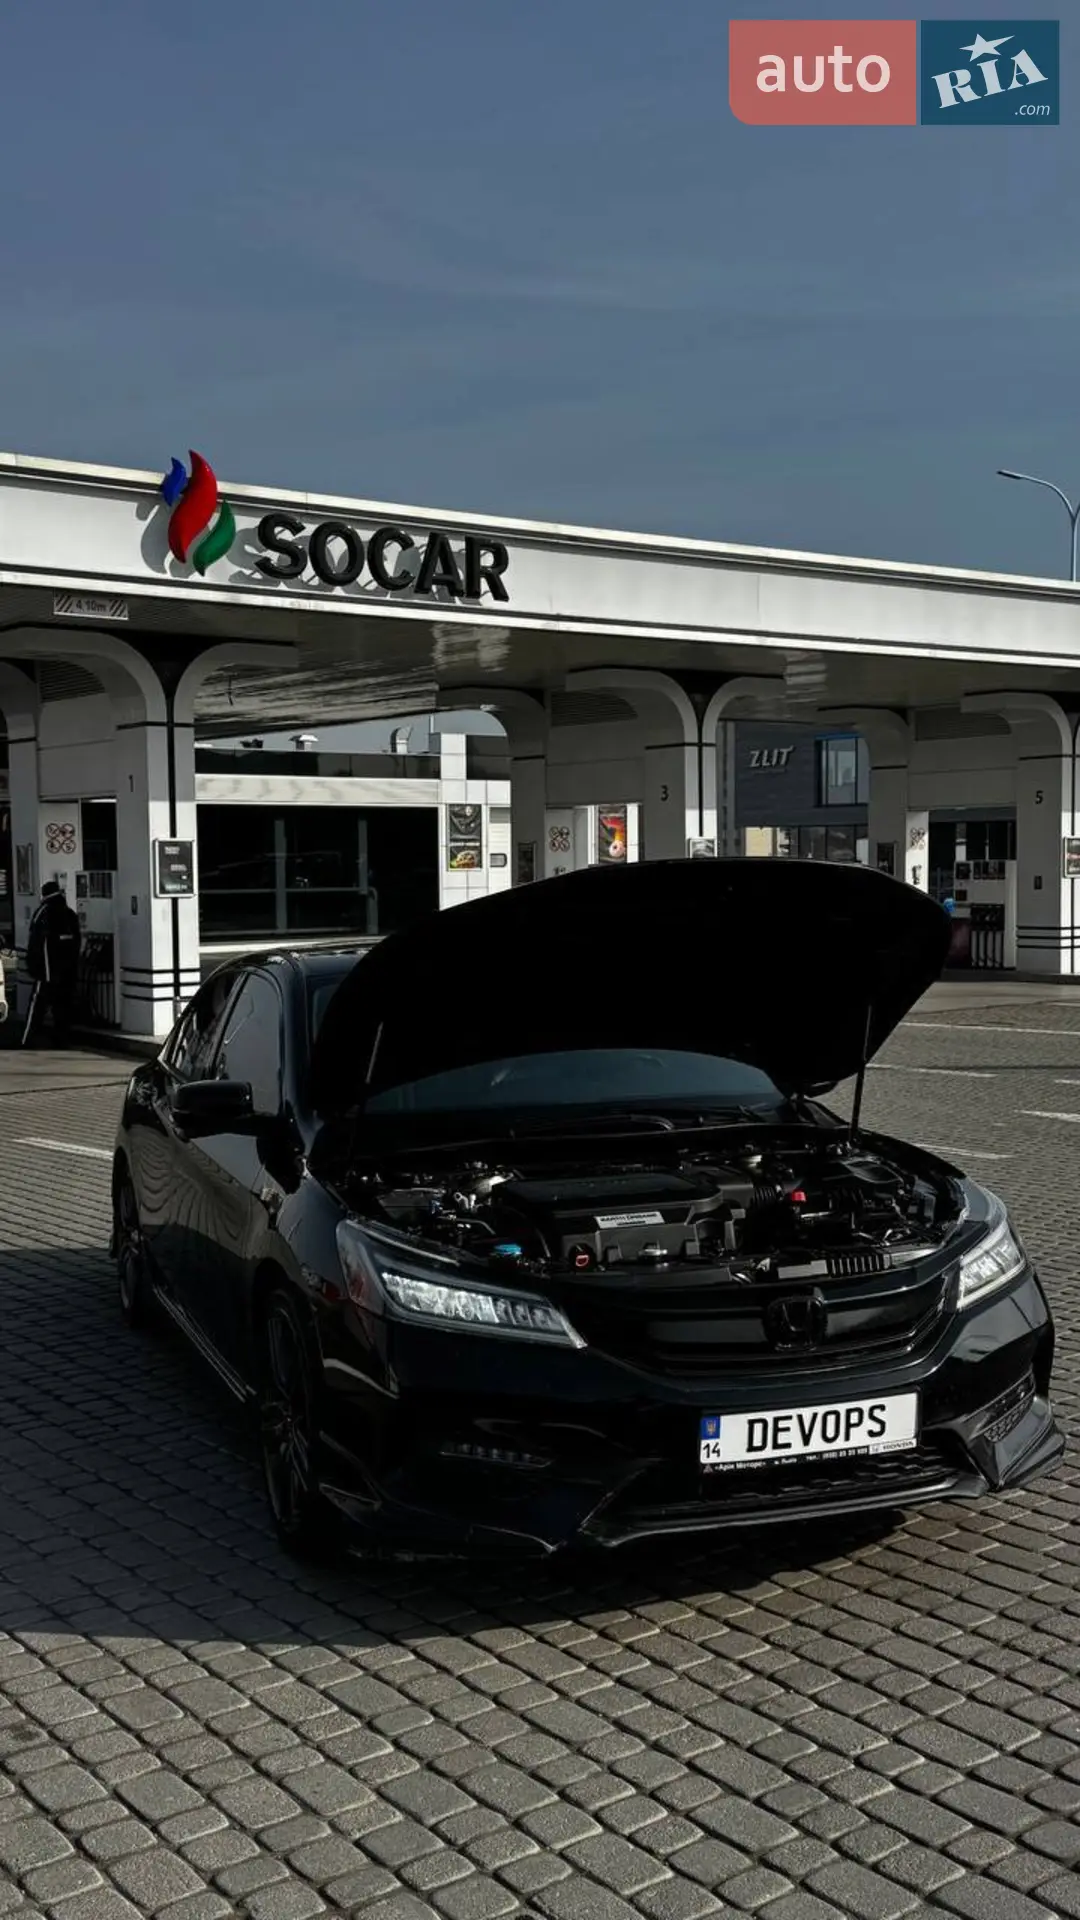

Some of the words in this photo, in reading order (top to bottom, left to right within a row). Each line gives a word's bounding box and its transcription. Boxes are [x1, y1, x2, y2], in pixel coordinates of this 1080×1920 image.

[254, 512, 510, 602] SOCAR
[750, 744, 795, 768] ZLIT
[660, 784, 670, 802] 3
[1034, 790, 1044, 805] 5
[746, 1403, 887, 1453] DEVOPS
[702, 1442, 721, 1459] 14
